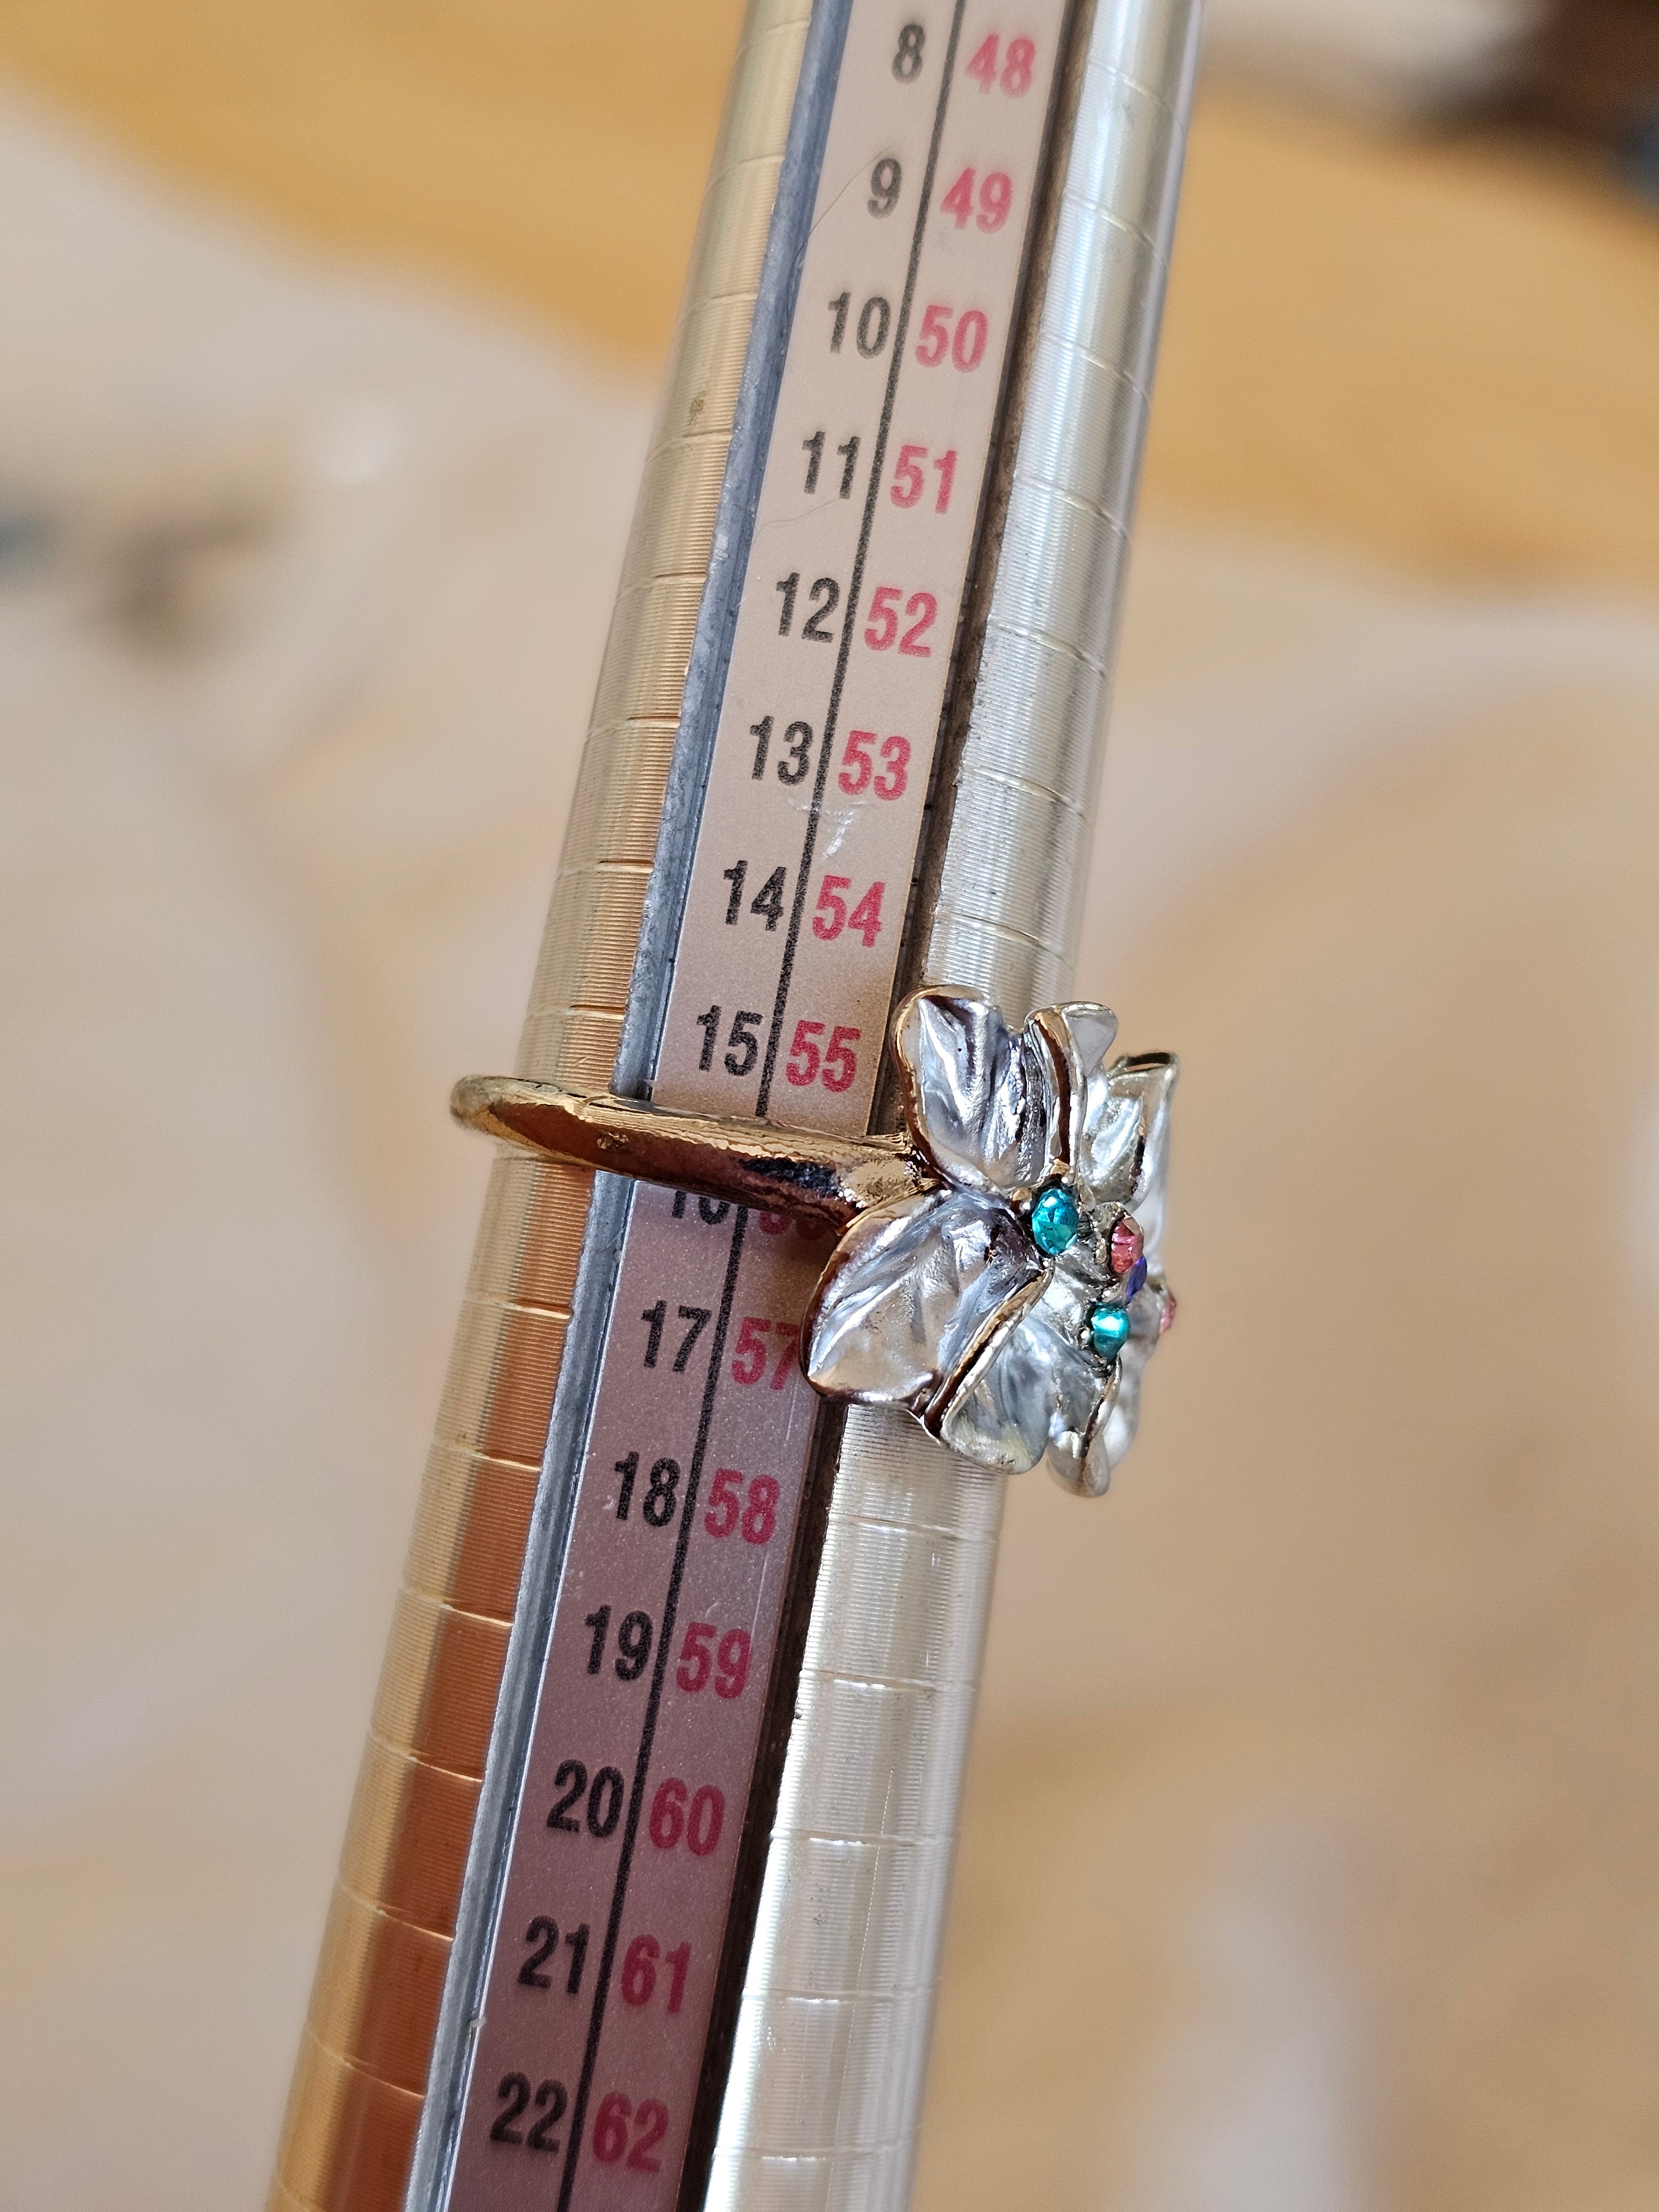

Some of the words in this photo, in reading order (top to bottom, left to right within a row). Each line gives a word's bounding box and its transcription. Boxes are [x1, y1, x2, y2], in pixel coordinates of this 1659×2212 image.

[891, 20, 928, 83] 8
[967, 32, 1038, 96] 48
[867, 156, 904, 219] 9
[941, 167, 1014, 233] 49
[827, 289, 893, 358] 10
[915, 301, 990, 372] 50
[801, 429, 862, 500] 11
[889, 442, 959, 514] 51
[775, 570, 842, 644] 12
[863, 584, 939, 658] 52
[748, 713, 815, 787] 13
[837, 728, 913, 802] 53
[722, 858, 788, 933] 14
[811, 872, 886, 948] 54
[695, 1003, 764, 1078] 15
[784, 1019, 863, 1094] 55
[639, 1298, 713, 1375] 17
[730, 1316, 800, 1391] 57
[612, 1449, 682, 1530] 18
[702, 1467, 781, 1547] 58
[583, 1604, 654, 1684] 19
[674, 1621, 754, 1702] 59
[544, 1759, 625, 1840] 20
[647, 1777, 726, 1859] 60
[515, 1915, 591, 1999] 21
[619, 1934, 691, 2015] 61
[487, 2072, 568, 2156] 22
[591, 2093, 670, 2174] 62
